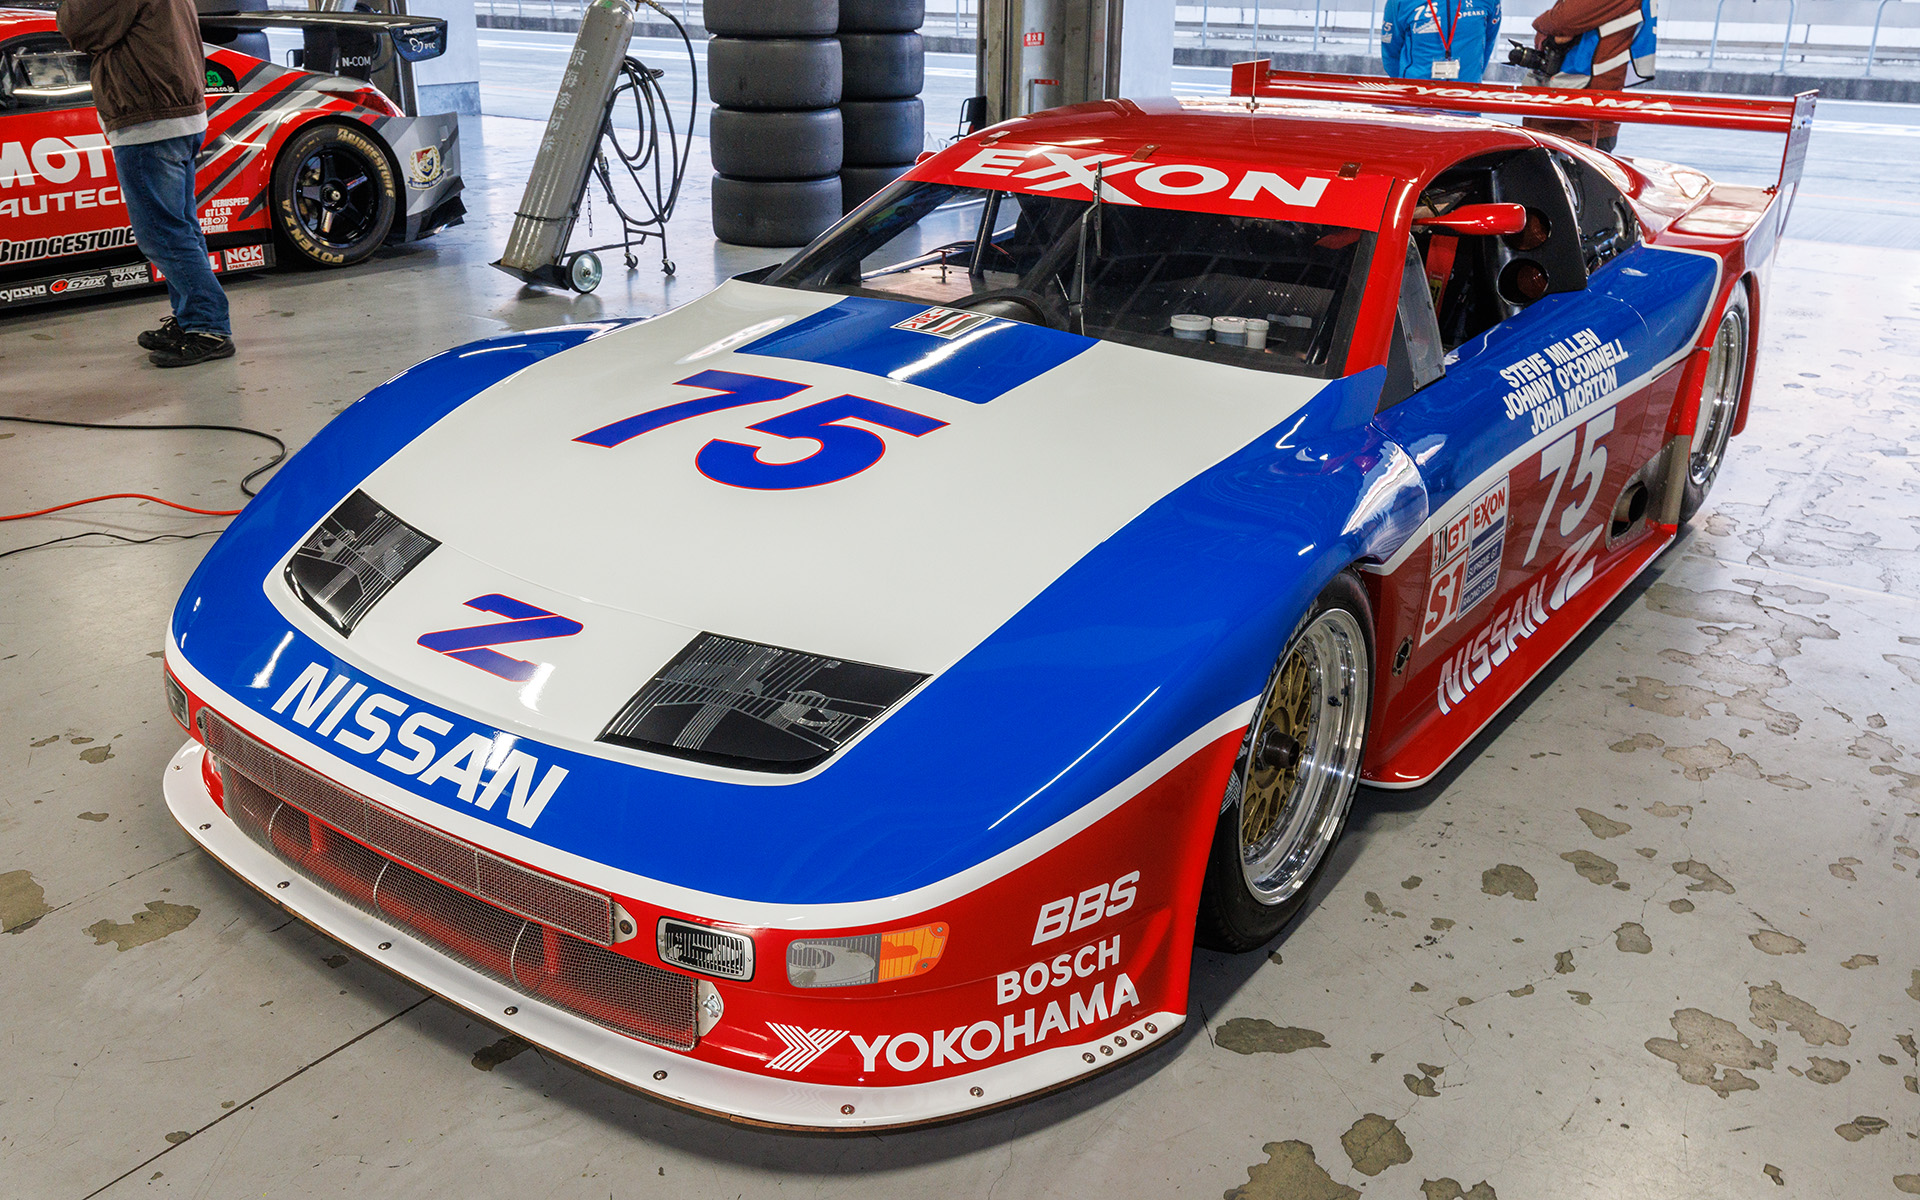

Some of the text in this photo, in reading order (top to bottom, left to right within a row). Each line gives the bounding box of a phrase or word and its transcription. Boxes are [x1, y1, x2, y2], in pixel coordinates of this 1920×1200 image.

[341, 56, 372, 67] N-COM
[1415, 85, 1674, 110] YOKOHAMA
[0, 133, 109, 189] MOT
[954, 148, 1331, 207] EXXON
[226, 245, 262, 264] NGK
[281, 199, 345, 264] POTENZA
[112, 270, 148, 282] RAYS
[228, 260, 264, 271] SPARK PLUGS
[1499, 327, 1602, 388] STEVE MILLEN
[1502, 338, 1629, 421] JOHNNY O'CONNELL
[572, 369, 951, 491] 75
[1530, 366, 1618, 436] JOHN MORTON
[1473, 487, 1506, 529] EXXON
[1522, 406, 1617, 568] 75
[1447, 514, 1470, 553] GT
[1424, 560, 1466, 635] S1
[1436, 571, 1550, 716] NISSAN
[271, 661, 570, 829] NISSAN
[1031, 870, 1141, 945] BBS
[996, 935, 1121, 1005] BOSCH
[849, 972, 1140, 1073] YOKOHAMA
